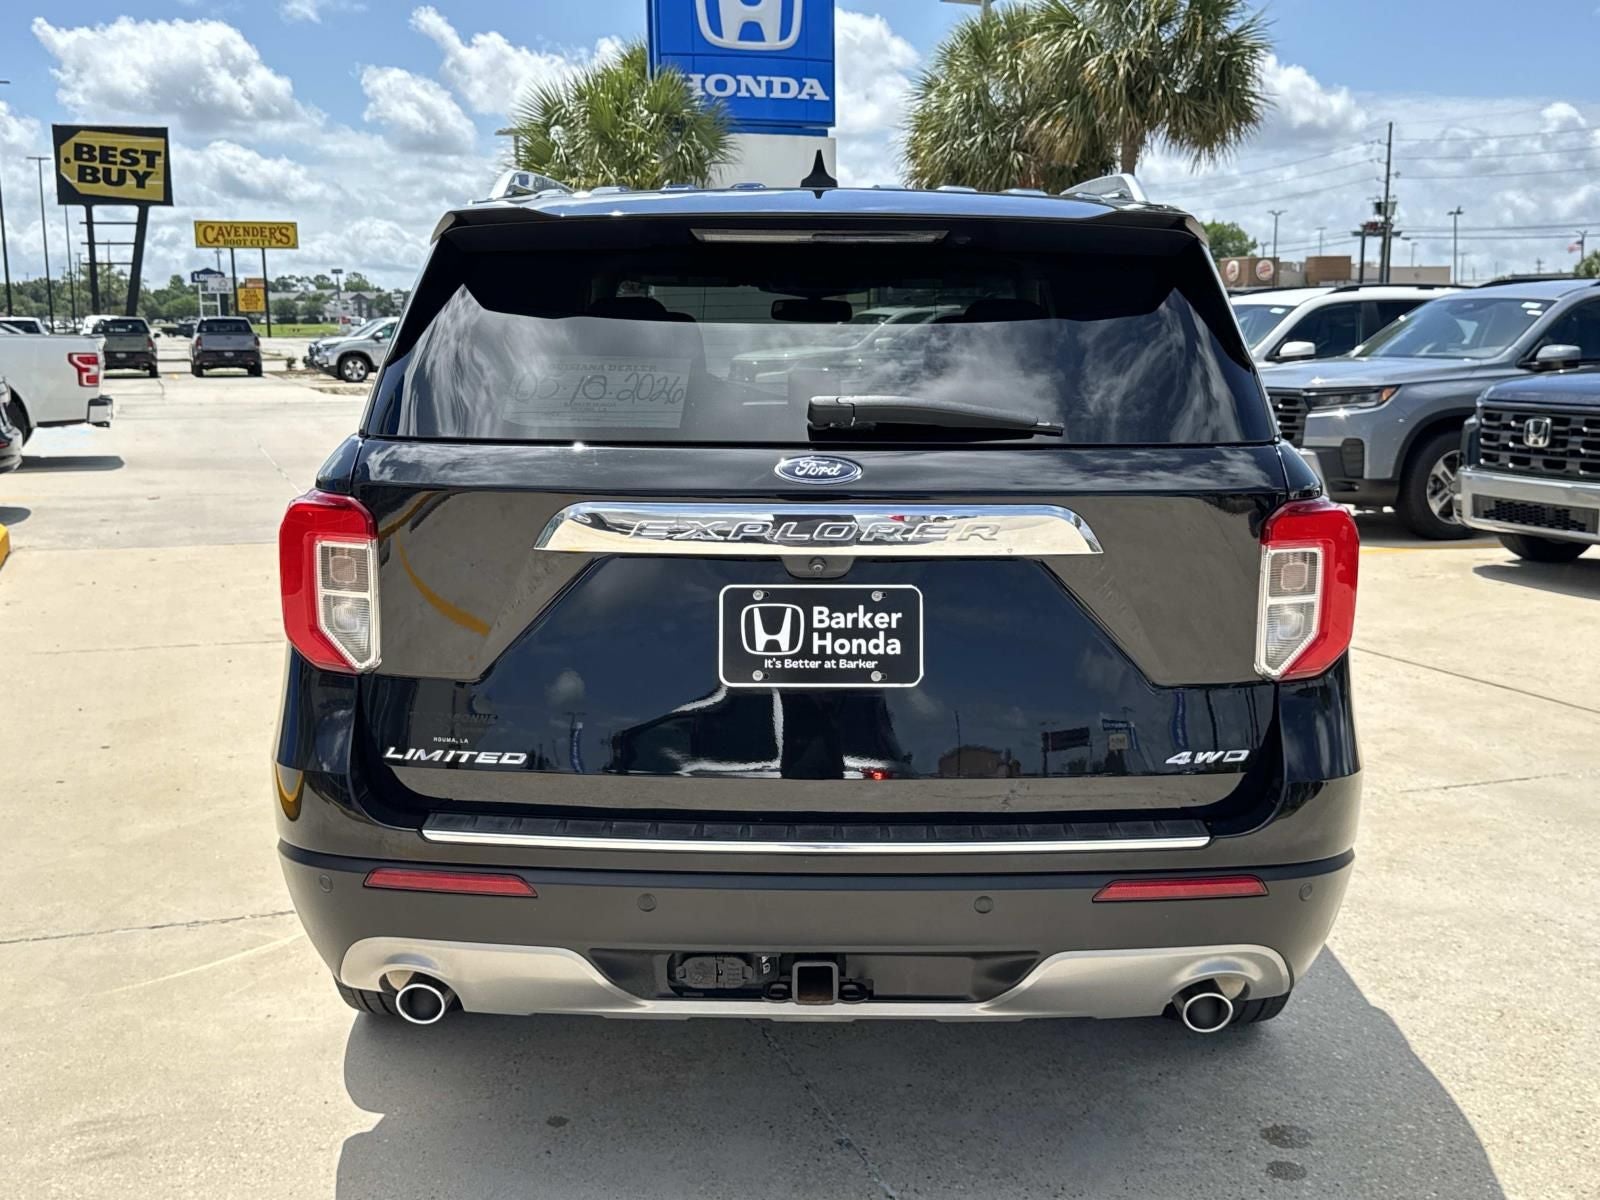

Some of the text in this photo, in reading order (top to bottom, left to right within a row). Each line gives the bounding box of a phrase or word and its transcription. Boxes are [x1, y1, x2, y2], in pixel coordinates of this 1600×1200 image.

[74, 142, 162, 168] BEST
[77, 164, 154, 189] BUY
[203, 224, 290, 245] CAVENDER'S
[250, 238, 273, 246] CITY
[794, 460, 843, 476] Ford
[629, 520, 1002, 542] EXPLORER
[812, 605, 902, 629] Barker
[812, 631, 901, 655] Honda
[764, 658, 878, 669] It's Better at Barker
[433, 736, 459, 744] HOUMA,
[383, 746, 528, 765] LIMITED
[1165, 749, 1250, 765] 4WD
